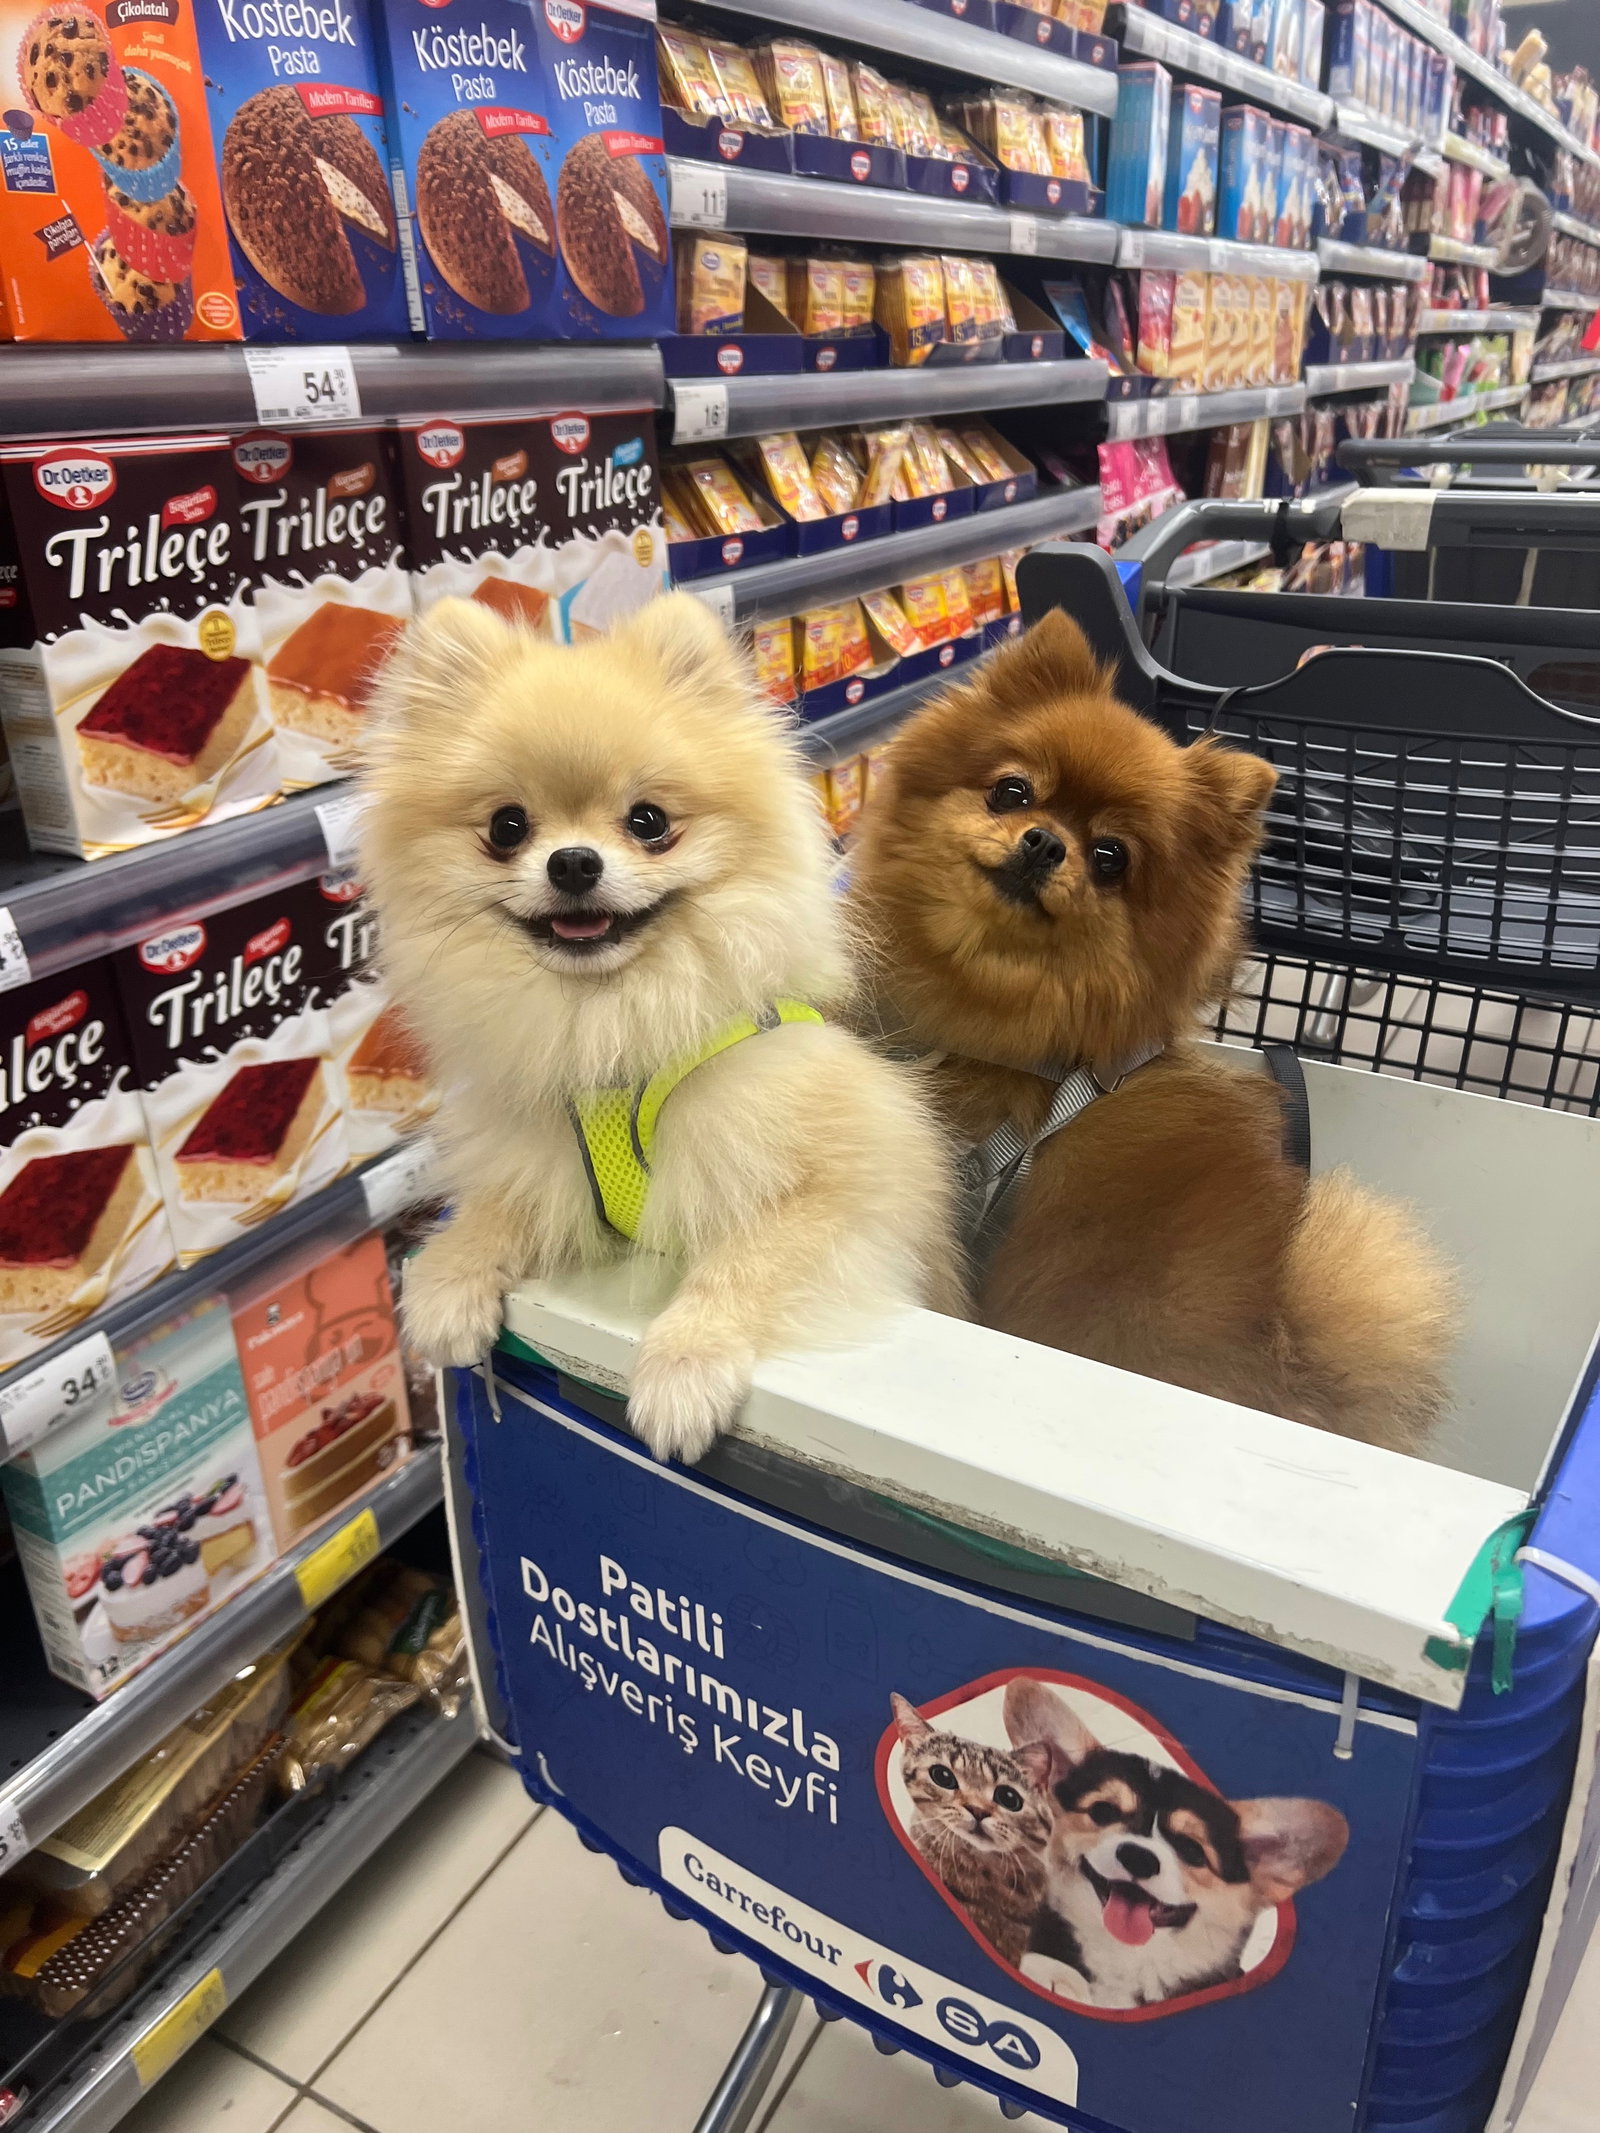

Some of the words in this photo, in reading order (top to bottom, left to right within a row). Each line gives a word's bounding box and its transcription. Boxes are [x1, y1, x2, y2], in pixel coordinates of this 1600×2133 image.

[117, 1, 169, 23] Çikolatalı
[124, 43, 149, 57] daha
[267, 45, 320, 77] Pasta
[411, 22, 528, 73] Köstebek
[450, 72, 497, 102] Pasta
[553, 55, 641, 101] Köstebek
[583, 100, 617, 127] Pasta
[3, 138, 19, 151] 15
[43, 217, 74, 240] Çikolata
[302, 370, 336, 404] 54
[421, 471, 538, 538] Trileçe
[555, 457, 652, 518] Trileçe
[239, 487, 387, 562] Trileçe
[45, 514, 231, 599] Trileçe
[146, 943, 302, 1050] Trileçe
[61, 1366, 97, 1406] 34
[600, 1554, 724, 1659] Patili
[520, 1555, 840, 1771] Dostlarımızla
[529, 1614, 698, 1754] Alışveriş
[713, 1723, 837, 1824] Keyfi
[683, 1852, 843, 1967] Carrefour
